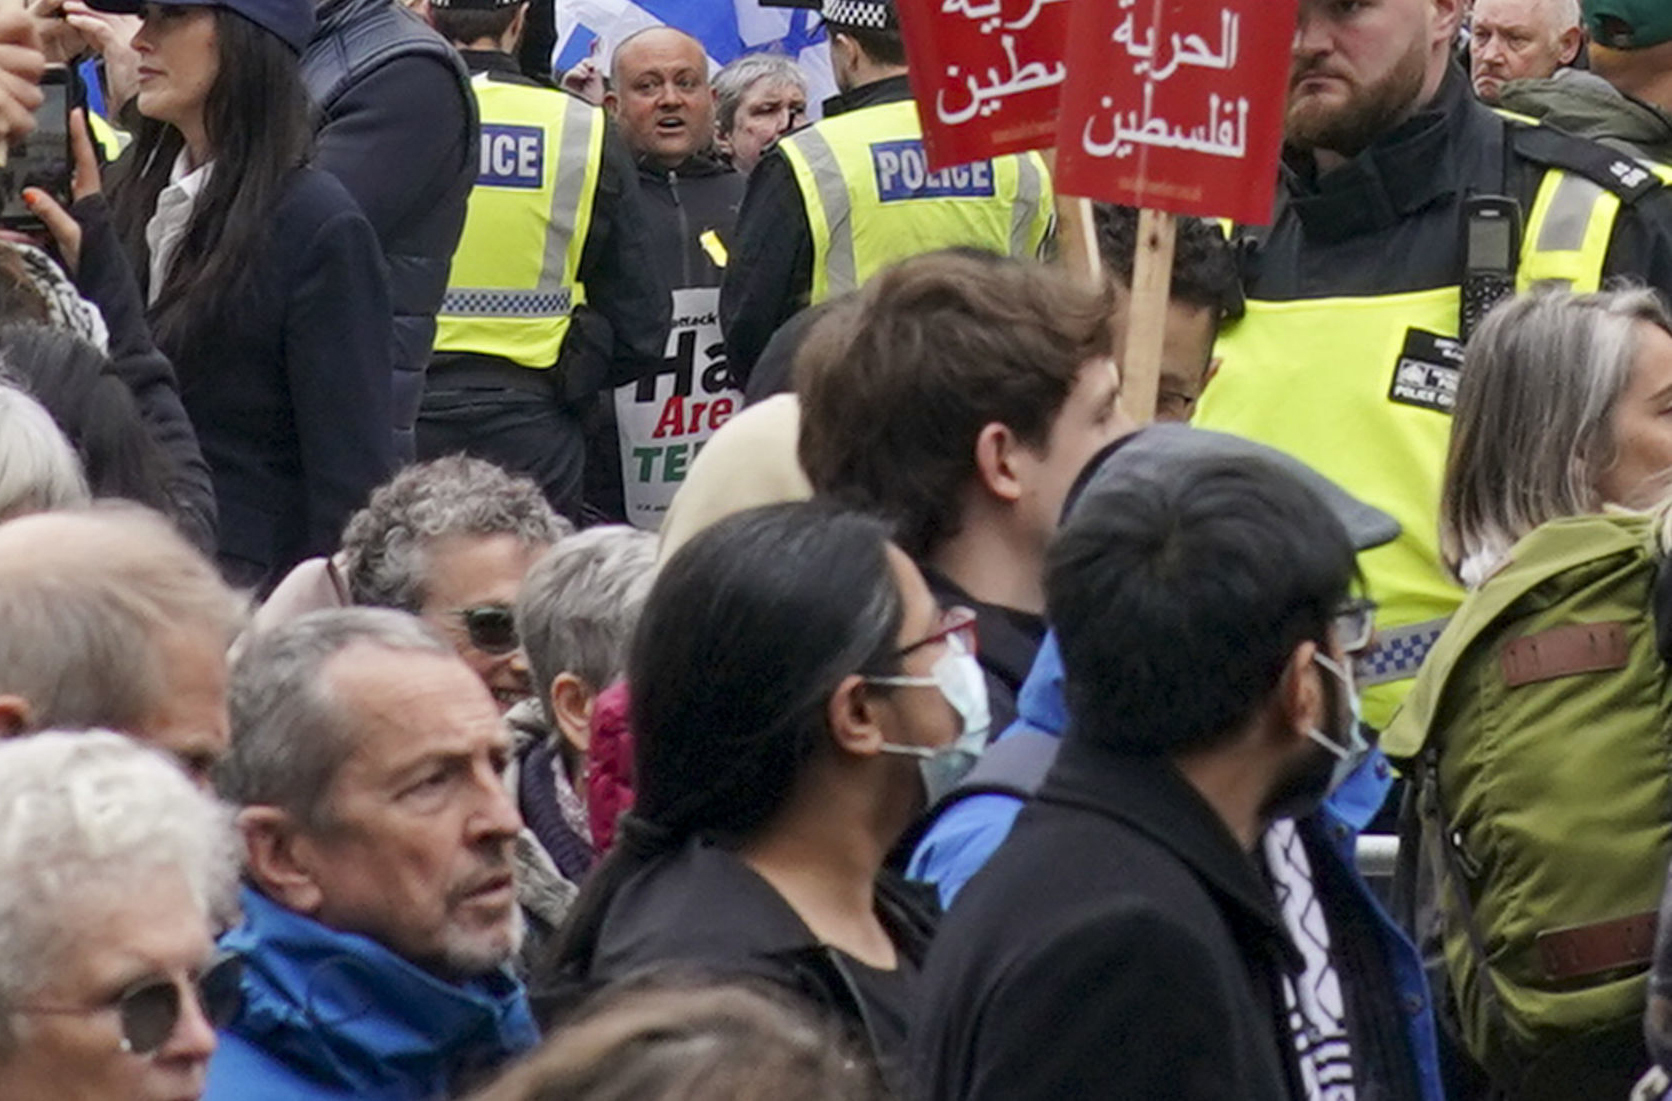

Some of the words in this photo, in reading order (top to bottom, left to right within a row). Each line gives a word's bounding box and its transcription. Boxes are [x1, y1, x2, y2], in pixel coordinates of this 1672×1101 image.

[1082, 81, 1249, 159] لفلسطين
[480, 133, 539, 178] ICE
[635, 329, 730, 404] Ha
[652, 393, 734, 440] Are
[632, 440, 707, 484] TE
